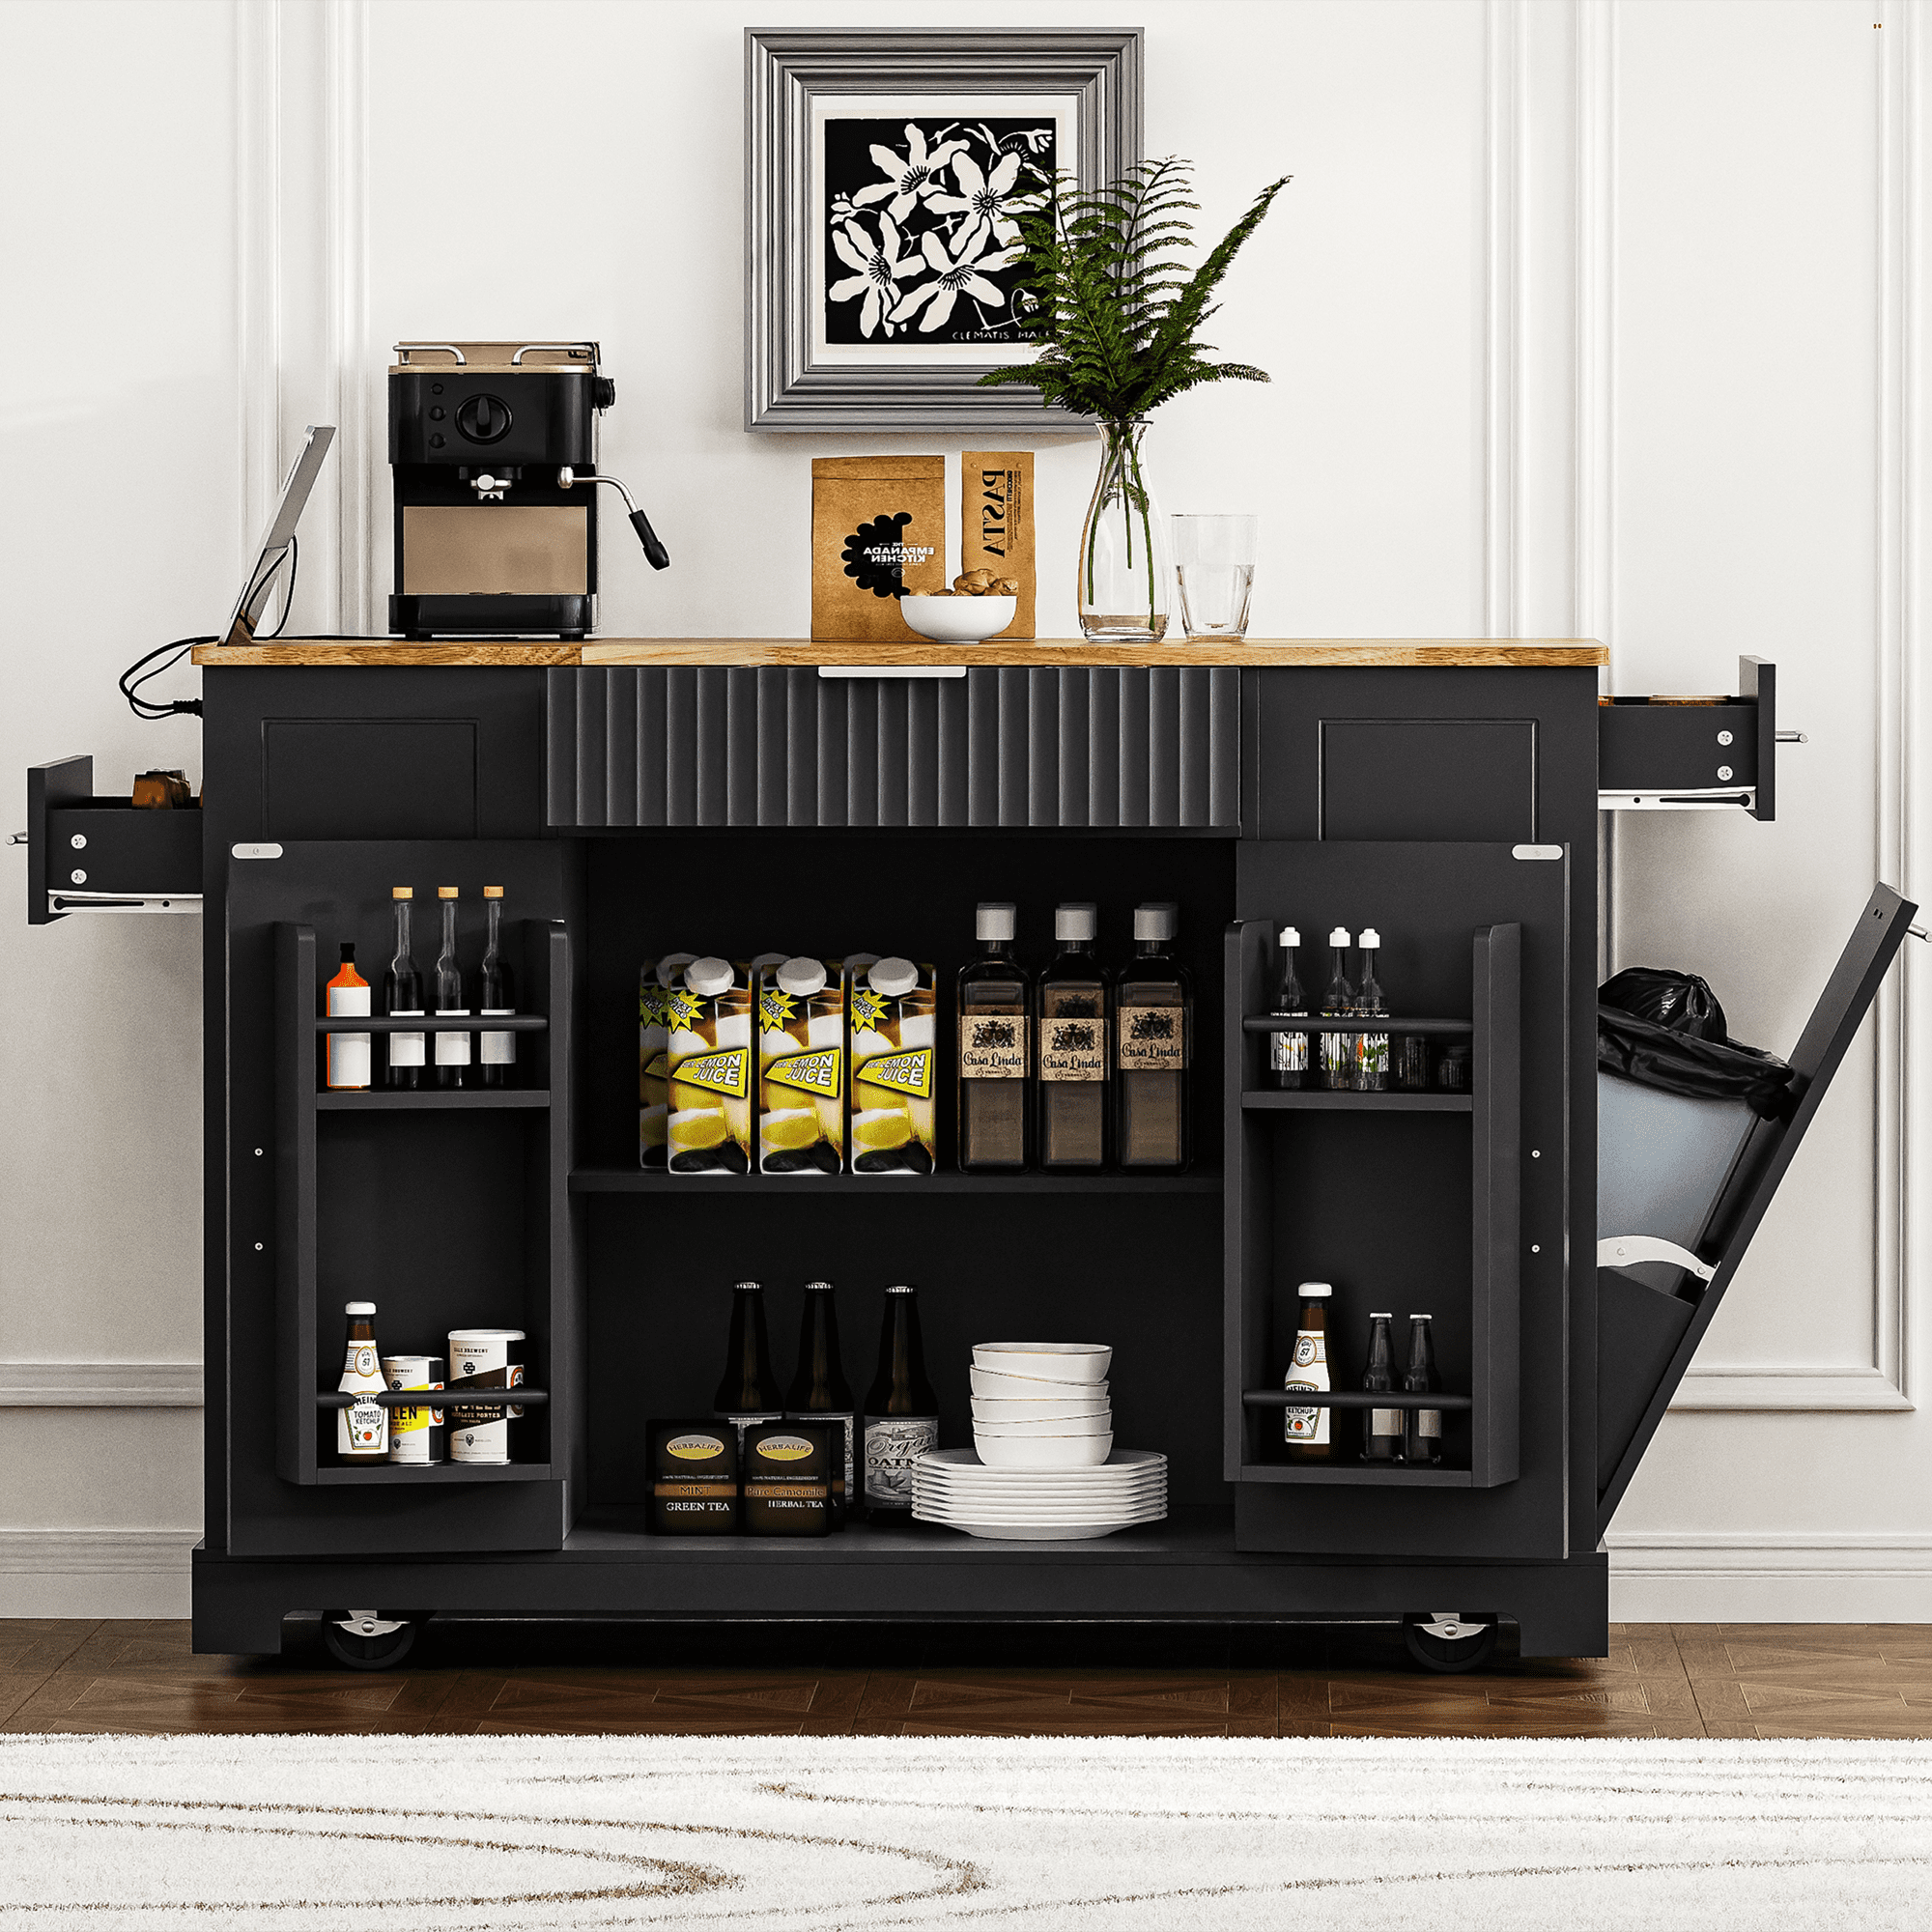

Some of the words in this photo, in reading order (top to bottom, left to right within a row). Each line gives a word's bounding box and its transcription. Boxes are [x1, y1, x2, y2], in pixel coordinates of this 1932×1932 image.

[952, 330, 1010, 340] CLEMATIS
[1122, 1042, 1147, 1058] Casa
[1148, 1042, 1180, 1059] Linda
[696, 1053, 742, 1067] LEMON
[787, 1053, 834, 1067] LEMON
[879, 1053, 925, 1067] LEMON
[963, 1051, 988, 1066] Casa
[989, 1051, 1022, 1067] Linda
[1043, 1053, 1068, 1068] Casa
[1069, 1054, 1101, 1070] Linda
[693, 1067, 740, 1087] JUICE
[785, 1067, 833, 1087] JUICE
[877, 1067, 924, 1087] JUICE
[1299, 1348, 1311, 1356] 57
[668, 1442, 721, 1452] HERBALIFE
[757, 1443, 812, 1453] HERBALIFE
[680, 1486, 711, 1495] MINT
[746, 1486, 770, 1496] Pure
[773, 1486, 824, 1496] Camomile
[666, 1501, 706, 1512] GREEN
[707, 1501, 730, 1512] TEA
[768, 1499, 805, 1508] HERBAL
[806, 1499, 824, 1508] TEA
